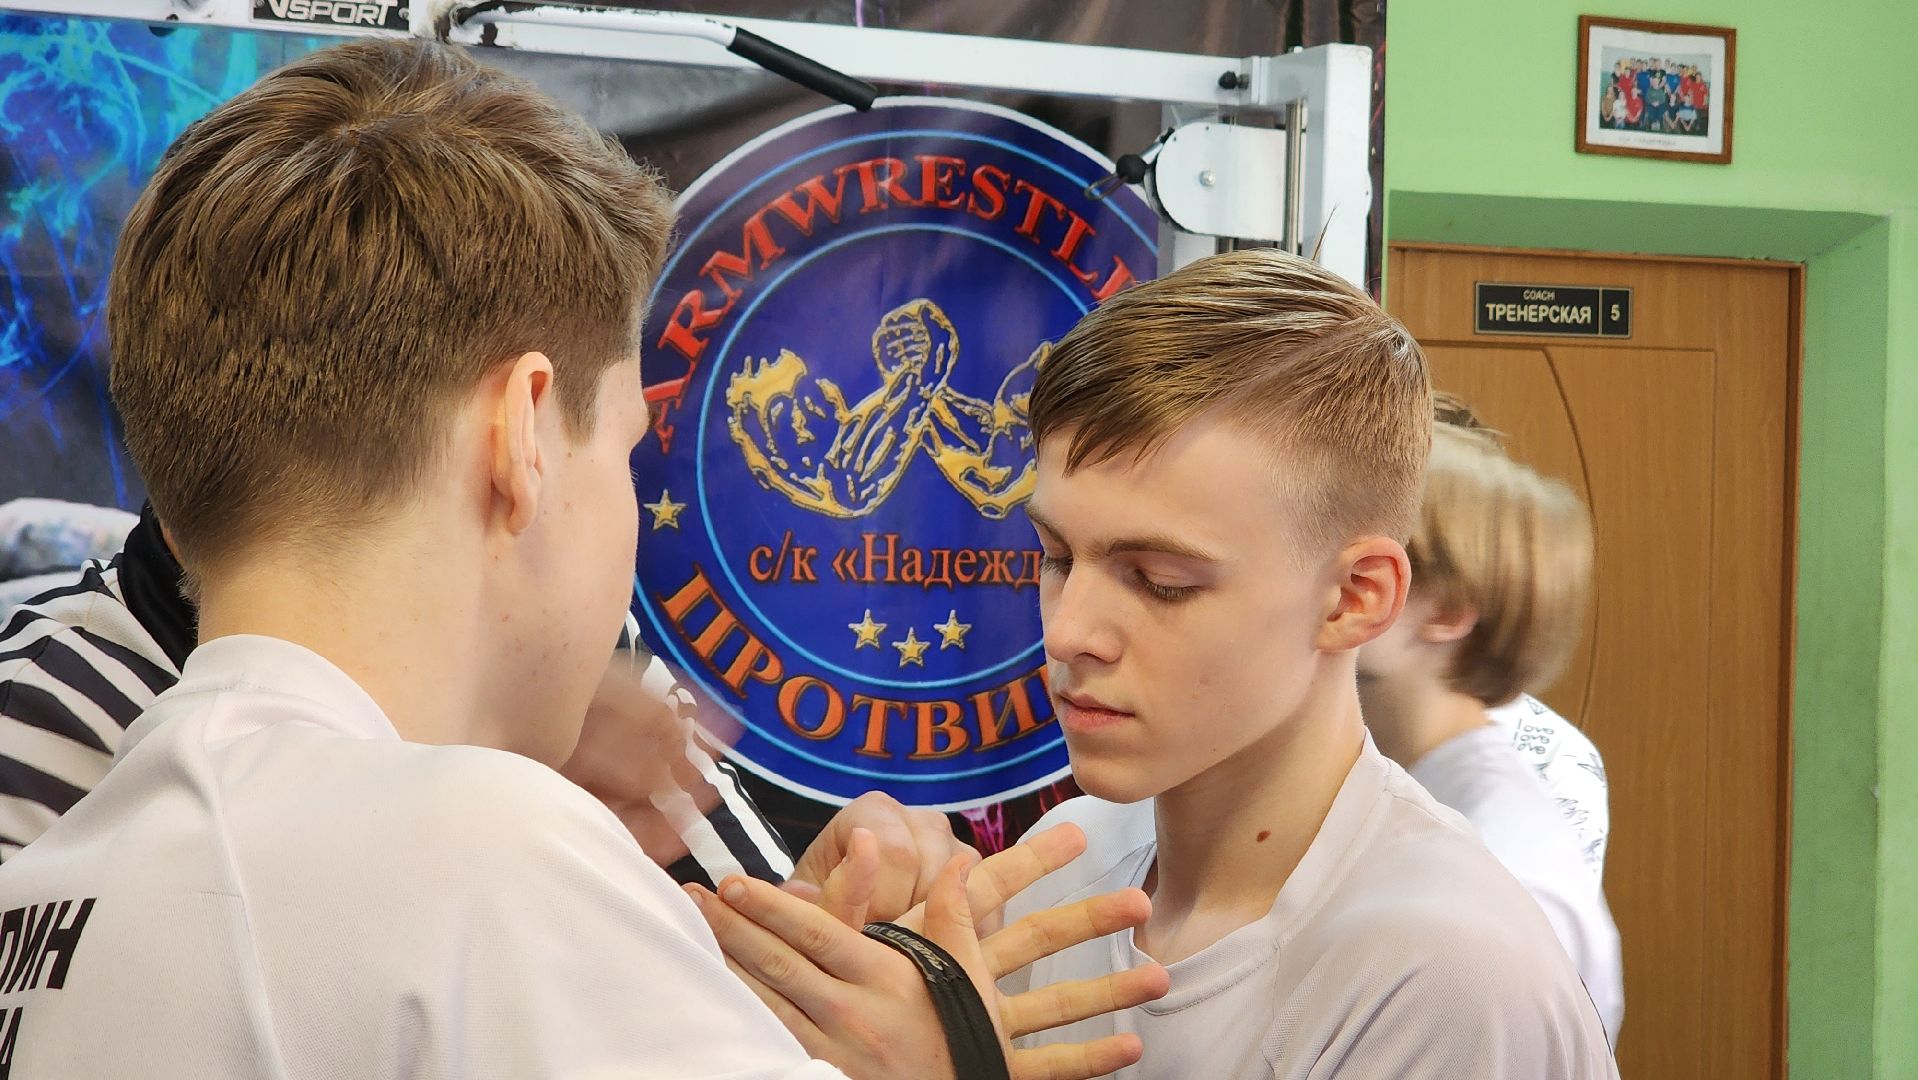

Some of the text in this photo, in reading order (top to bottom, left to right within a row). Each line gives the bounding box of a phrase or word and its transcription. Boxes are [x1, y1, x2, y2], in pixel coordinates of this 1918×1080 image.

[1522, 289, 1555, 301] COACH
[1485, 302, 1621, 324] ТРЕНЕРСКАЯ 5
[749, 530, 816, 582] с/к
[656, 563, 1057, 760] ПРОТВИ
[1516, 717, 1555, 735] love
[1513, 731, 1550, 744] love
